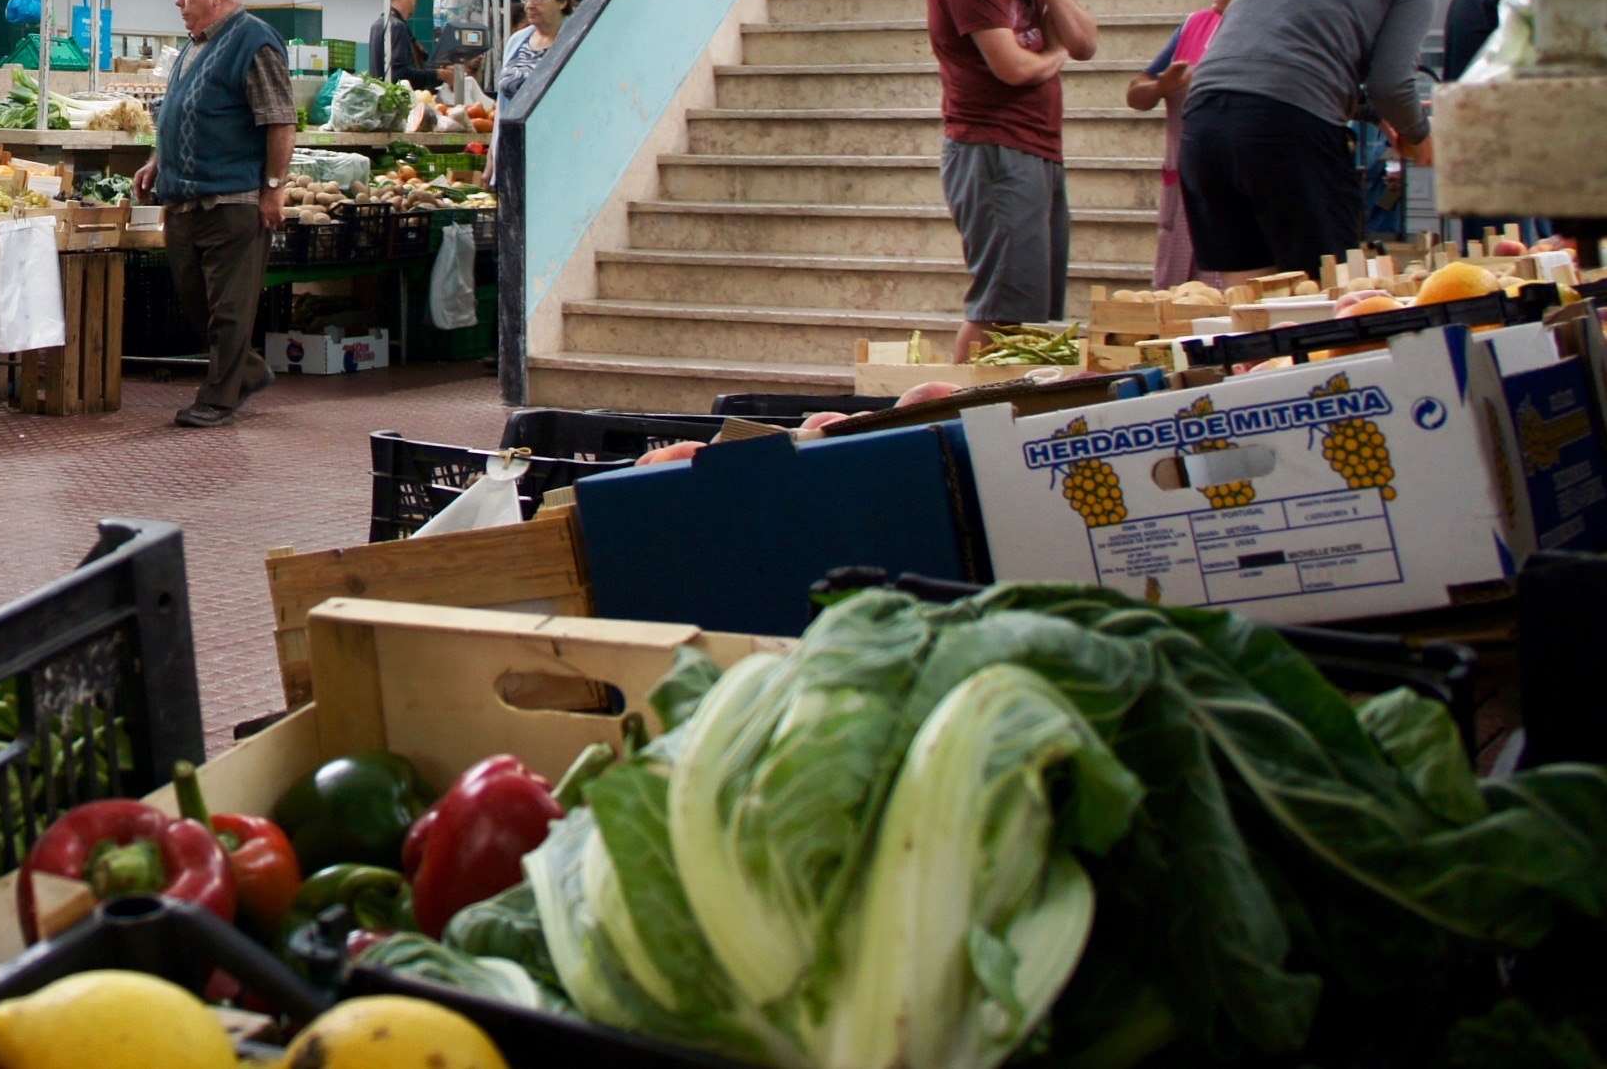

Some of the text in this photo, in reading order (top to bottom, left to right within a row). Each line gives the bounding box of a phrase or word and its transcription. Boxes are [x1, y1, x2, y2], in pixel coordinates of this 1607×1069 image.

[1026, 390, 1388, 466] HERDADE DE MITRENA
